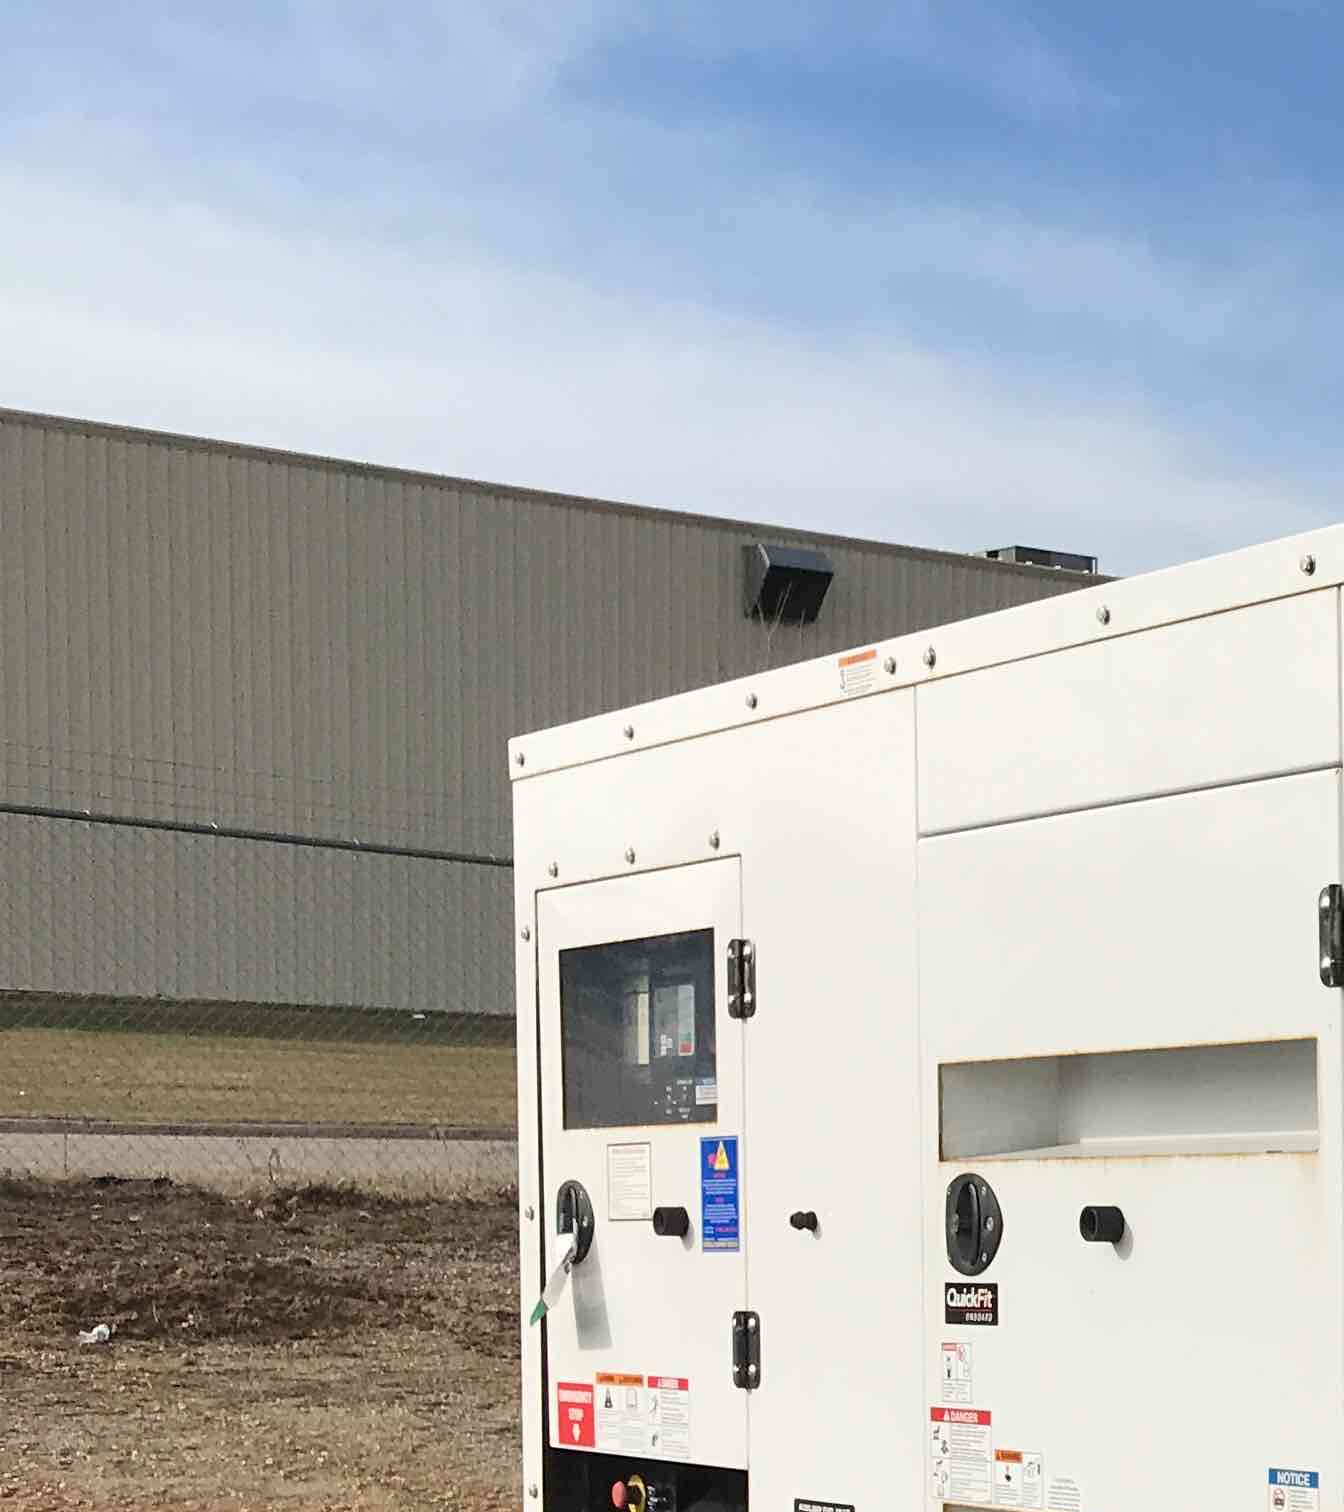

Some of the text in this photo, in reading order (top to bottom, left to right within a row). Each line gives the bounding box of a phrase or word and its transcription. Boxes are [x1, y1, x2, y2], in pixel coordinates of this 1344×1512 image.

[946, 1286, 993, 1308] QuickFit
[950, 1410, 979, 1424] DANGER
[1276, 1471, 1311, 1487] NOTICE
